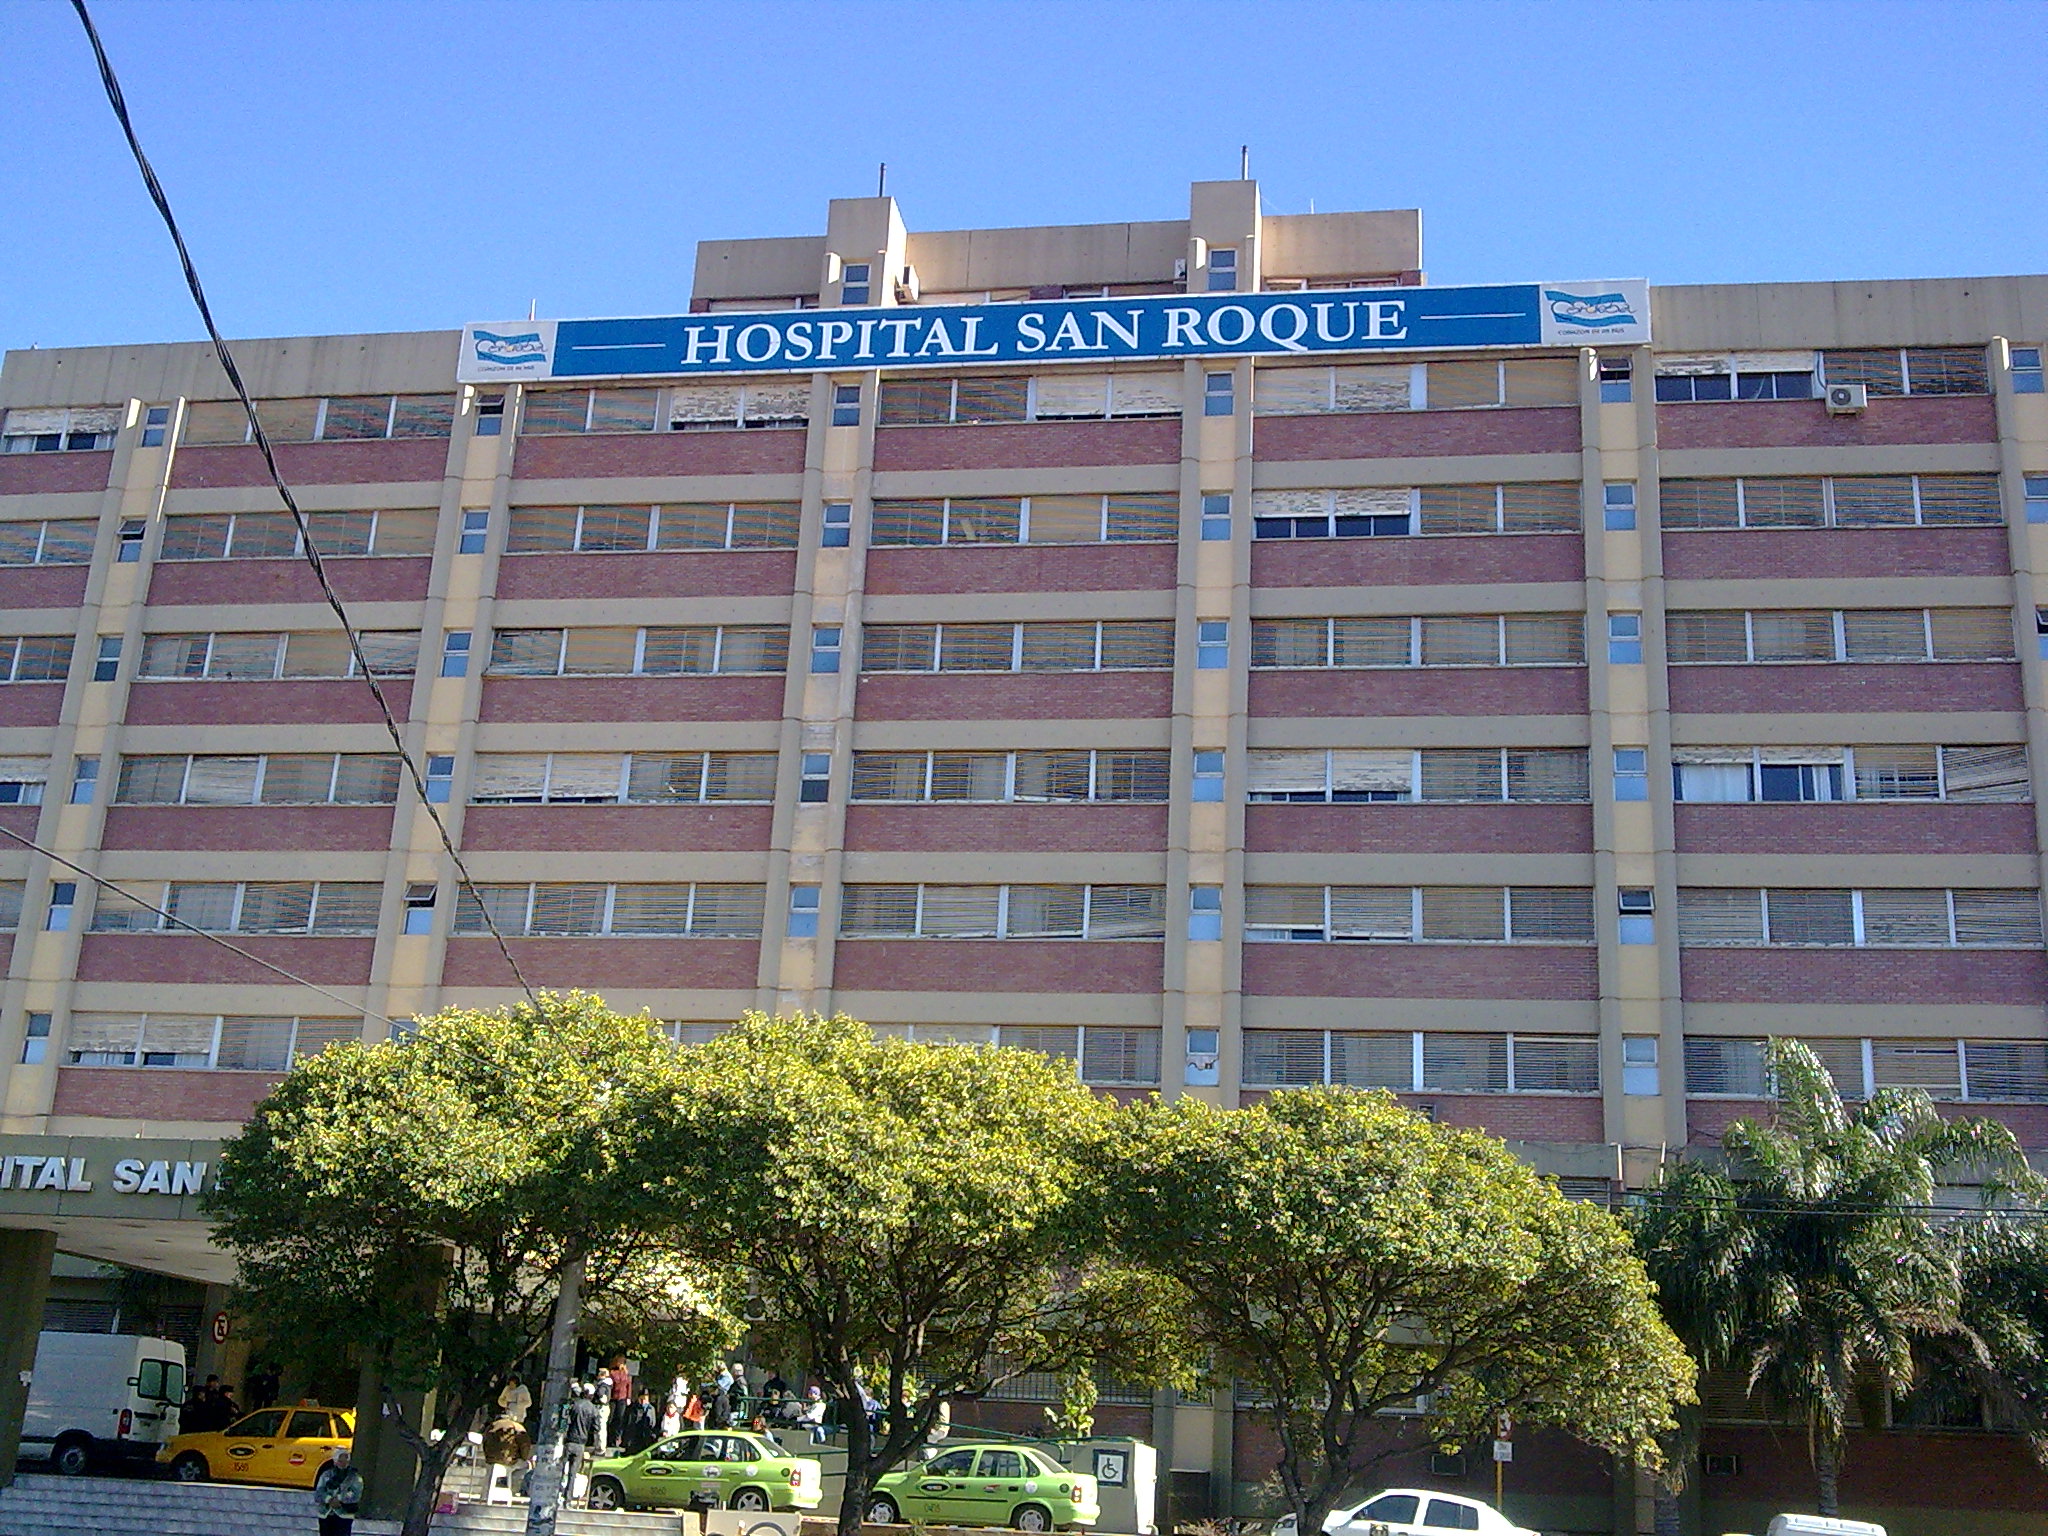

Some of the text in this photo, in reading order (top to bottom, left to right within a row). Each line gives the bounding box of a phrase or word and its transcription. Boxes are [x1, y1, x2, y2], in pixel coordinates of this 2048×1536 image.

[680, 299, 1409, 365] HOSPITAL SAN ROQUE
[0, 1155, 208, 1195] ITAL SAN
